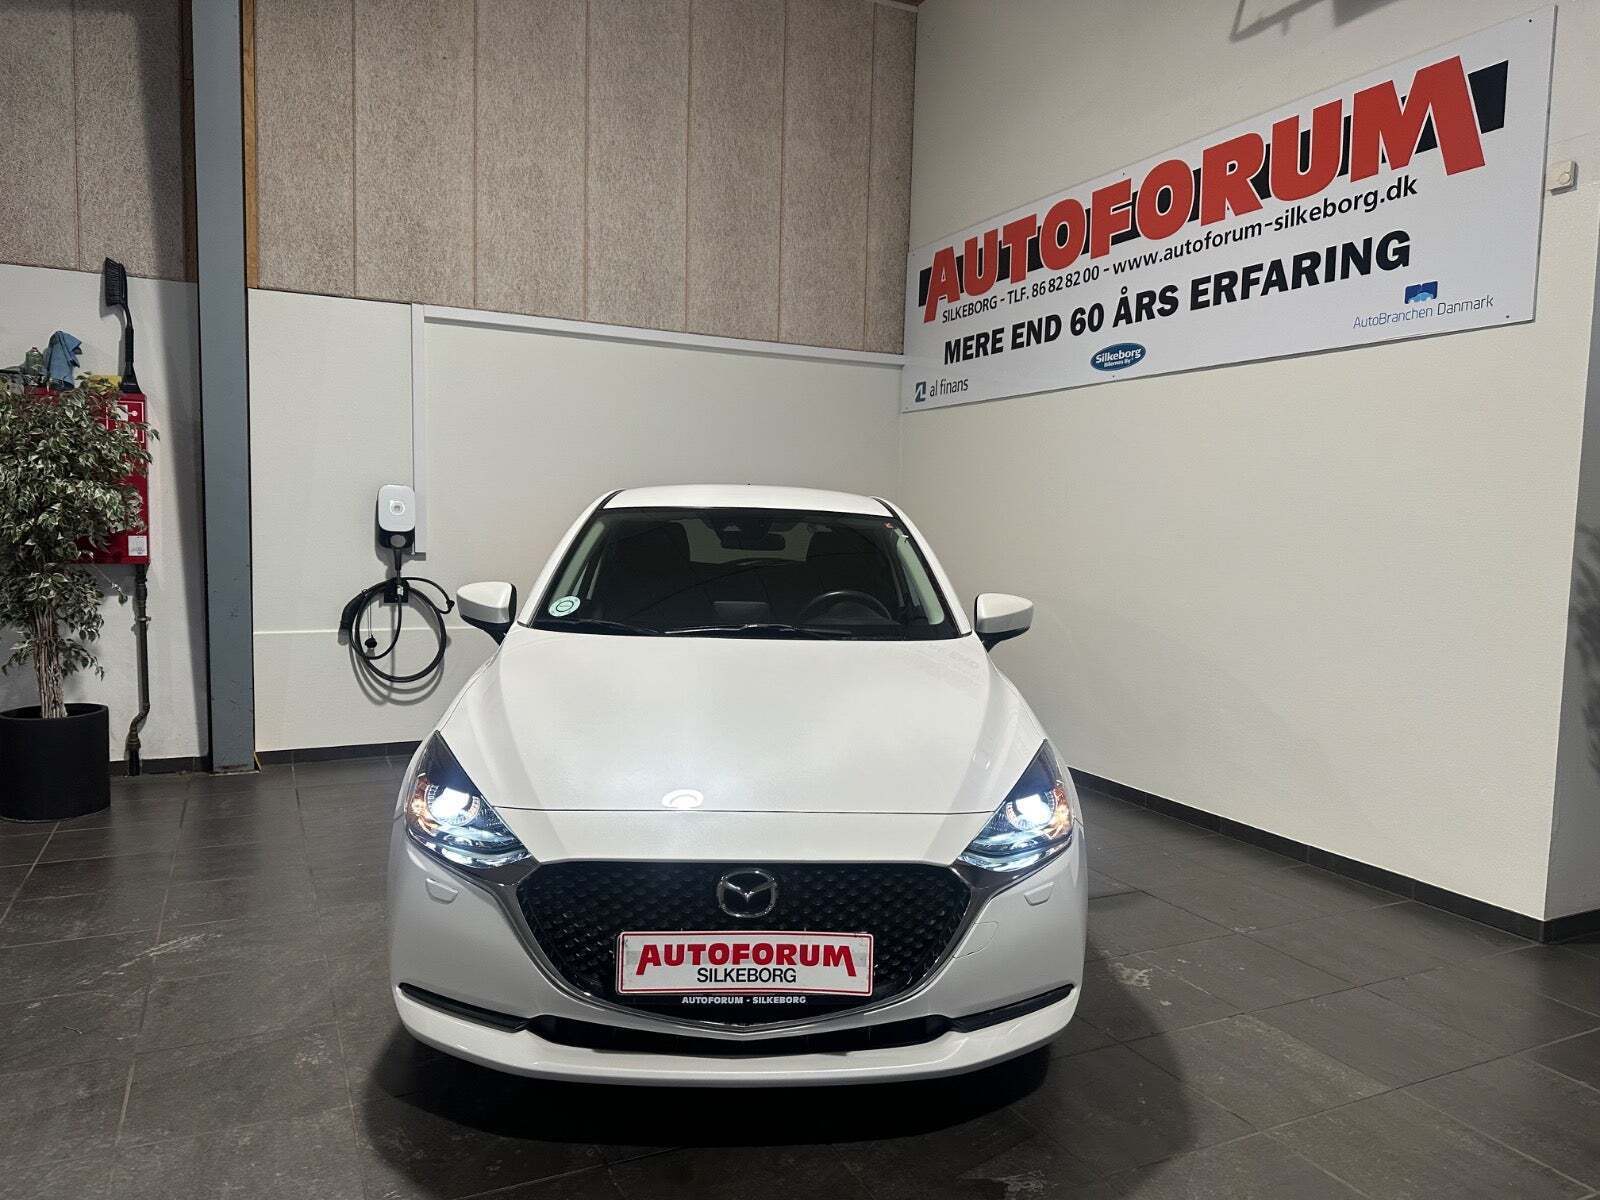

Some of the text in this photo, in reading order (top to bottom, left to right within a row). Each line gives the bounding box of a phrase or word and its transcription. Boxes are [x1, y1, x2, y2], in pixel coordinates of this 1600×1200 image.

[923, 54, 1486, 323] AUTOFORUM
[942, 295, 998, 324] SILKEBORG
[1007, 287, 1030, 306] TLF.
[1113, 175, 1418, 275] www.autoforum-silkeborg.dk
[944, 230, 1411, 366] MERE END 60 ÅRS ERFARING
[1353, 294, 1494, 329] AutoBranchen Danmark
[1095, 348, 1142, 364] Silkeborg
[930, 378, 969, 397] al finans
[635, 942, 857, 977] AUTOFORUM
[696, 967, 797, 984] SILKEBORG
[681, 996, 744, 1004] AUTOFORUM
[752, 996, 807, 1004] SILKEBORG
